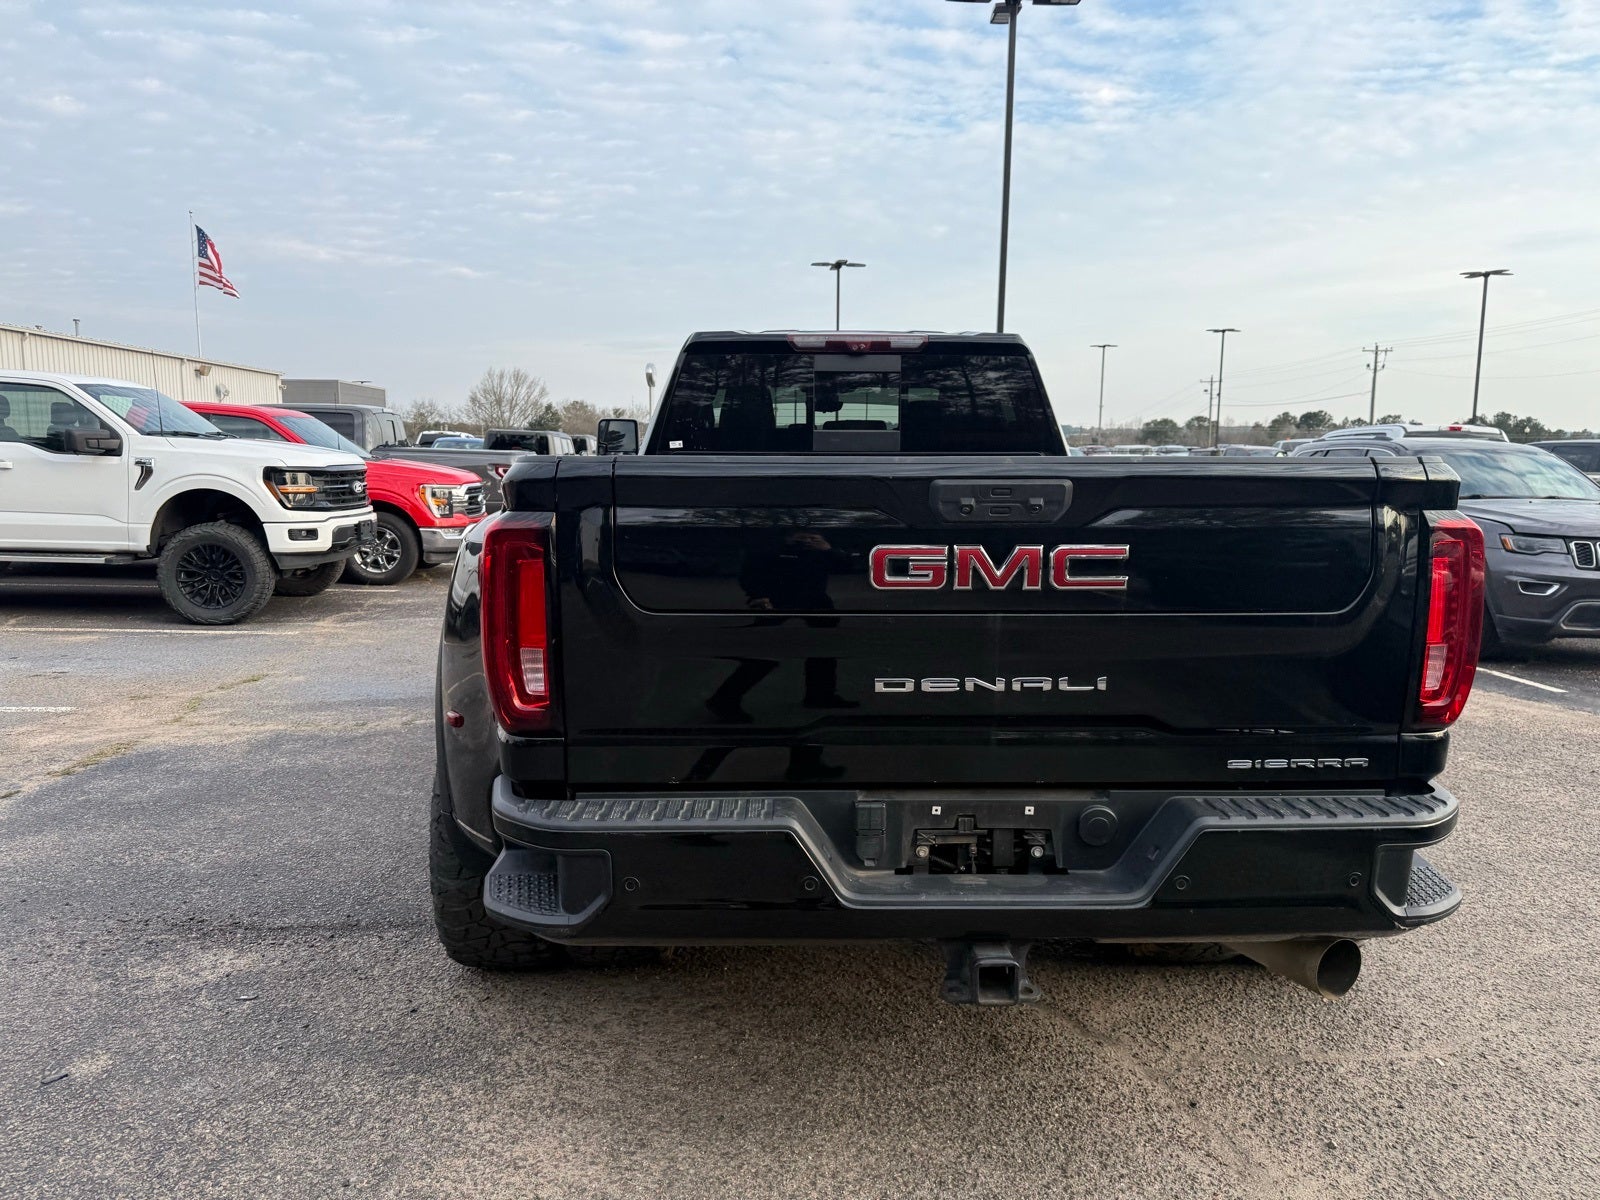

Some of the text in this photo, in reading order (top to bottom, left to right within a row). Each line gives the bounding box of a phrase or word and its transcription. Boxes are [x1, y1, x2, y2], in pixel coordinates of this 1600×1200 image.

[869, 545, 1130, 590] GMC
[874, 676, 1108, 693] DENALI
[1227, 757, 1369, 769] SIERRA
